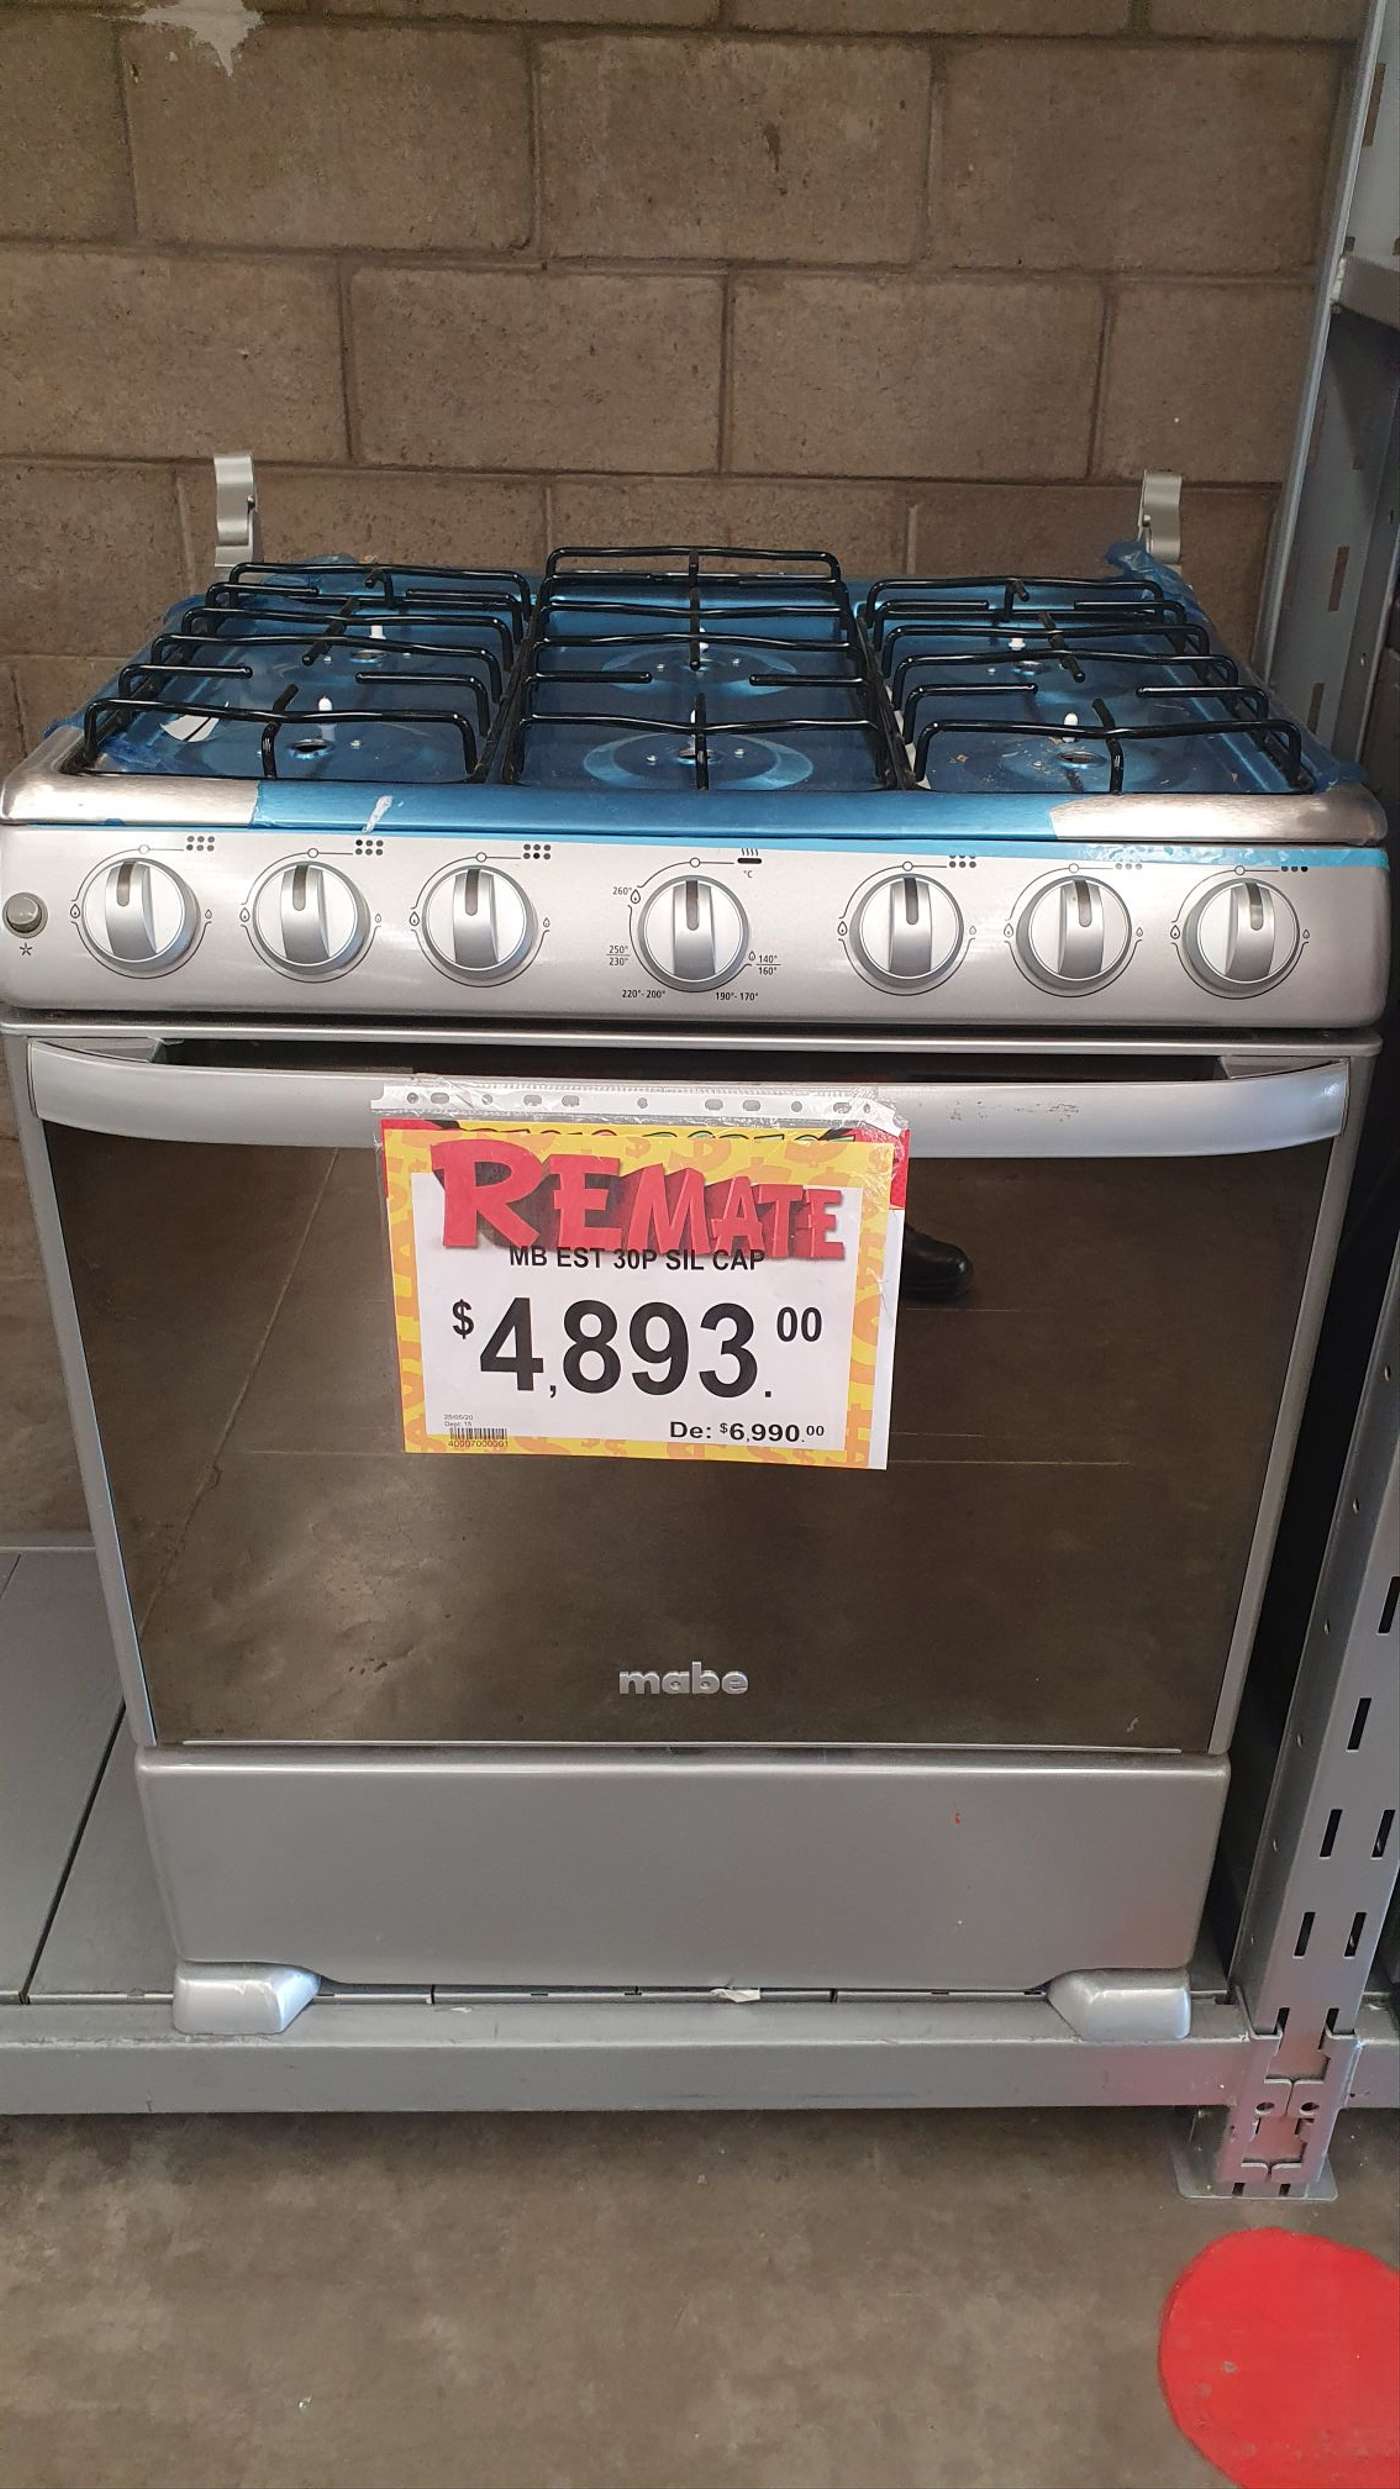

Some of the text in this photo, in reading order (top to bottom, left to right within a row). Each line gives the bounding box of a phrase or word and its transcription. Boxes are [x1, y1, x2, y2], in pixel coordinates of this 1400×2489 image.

[612, 886, 633, 896] 260°
[608, 945, 629, 954] 250°
[608, 957, 629, 966] 230°
[758, 954, 778, 963] 140°
[758, 966, 778, 976] 160°
[430, 1138, 845, 1260] REMATE
[509, 1247, 765, 1272] MB EST 30P SIL CAP
[669, 1420, 712, 1440] De:
[618, 1661, 749, 1695] mabe
